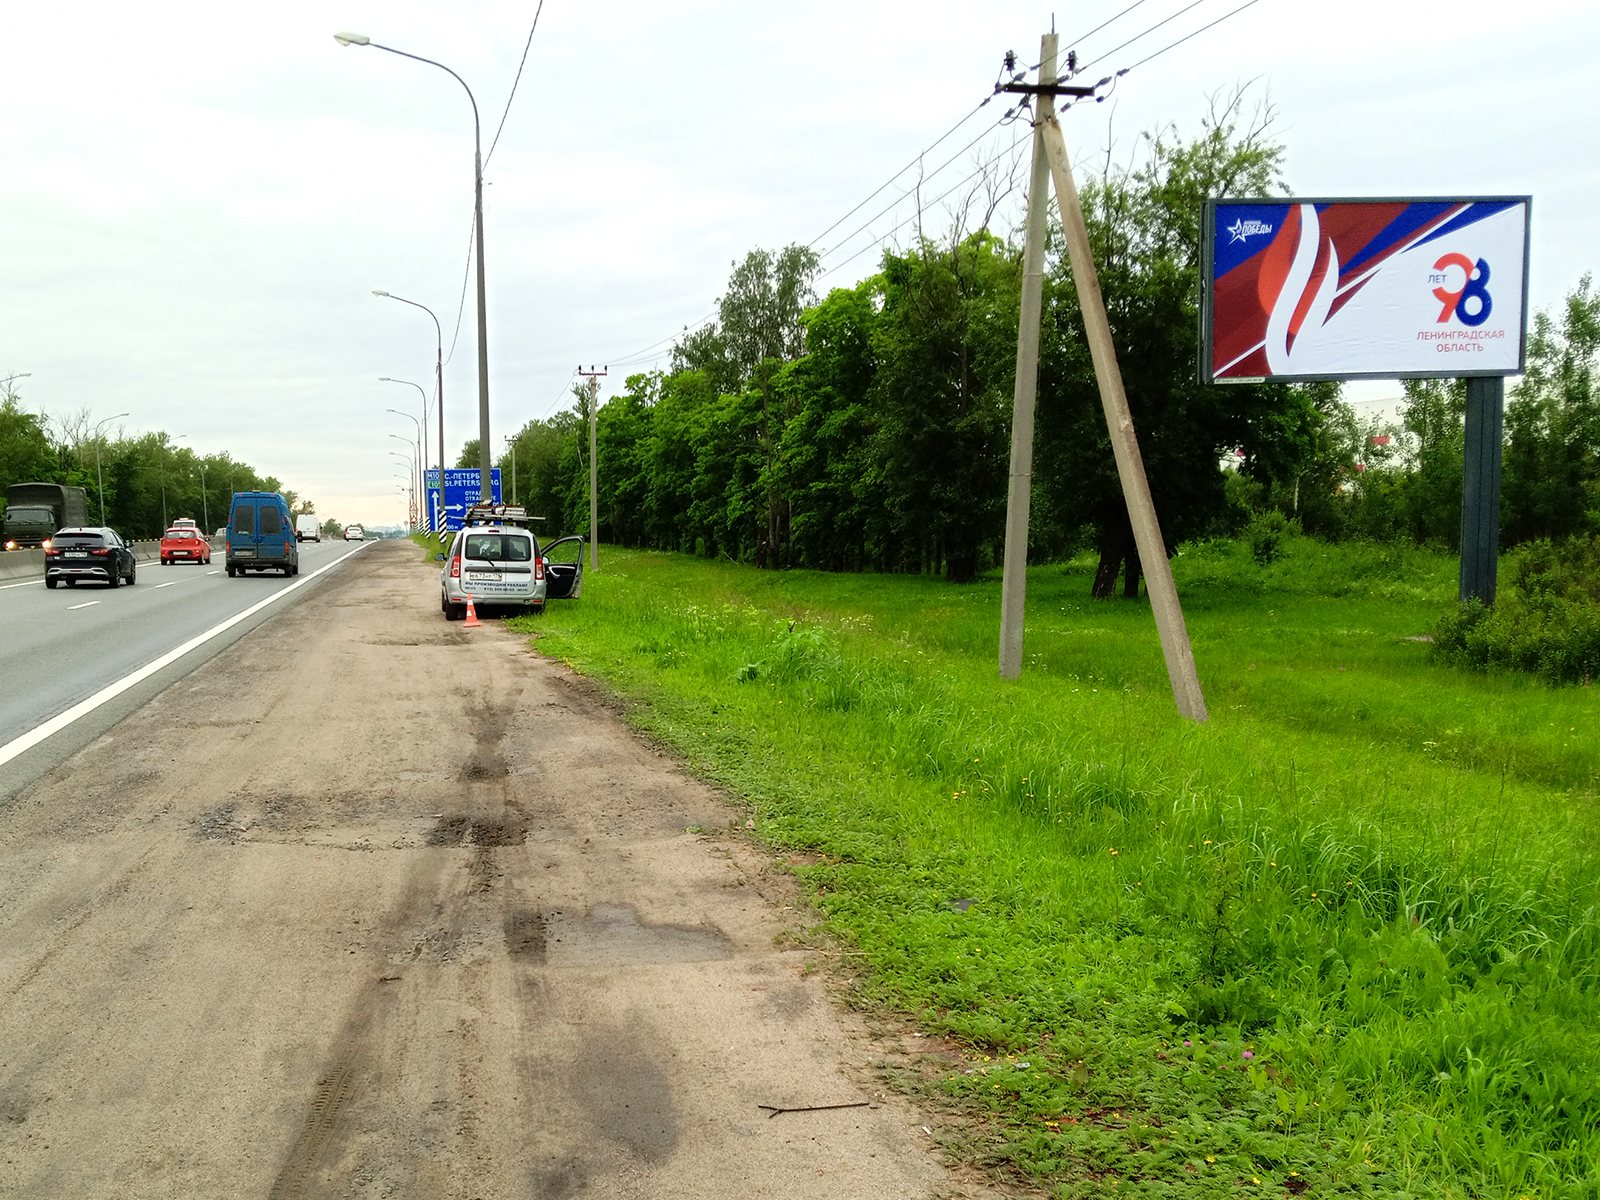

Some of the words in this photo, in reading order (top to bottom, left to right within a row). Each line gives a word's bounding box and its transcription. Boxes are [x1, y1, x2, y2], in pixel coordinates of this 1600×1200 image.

[1242, 224, 1272, 234] ПОБЕДЫ
[1427, 274, 1447, 284] ЛЕТ
[1432, 252, 1492, 327] 98
[1416, 329, 1505, 341] ЛЕНИНГРАДСКАЯ
[1436, 343, 1484, 353] ОБЛАСТЬ
